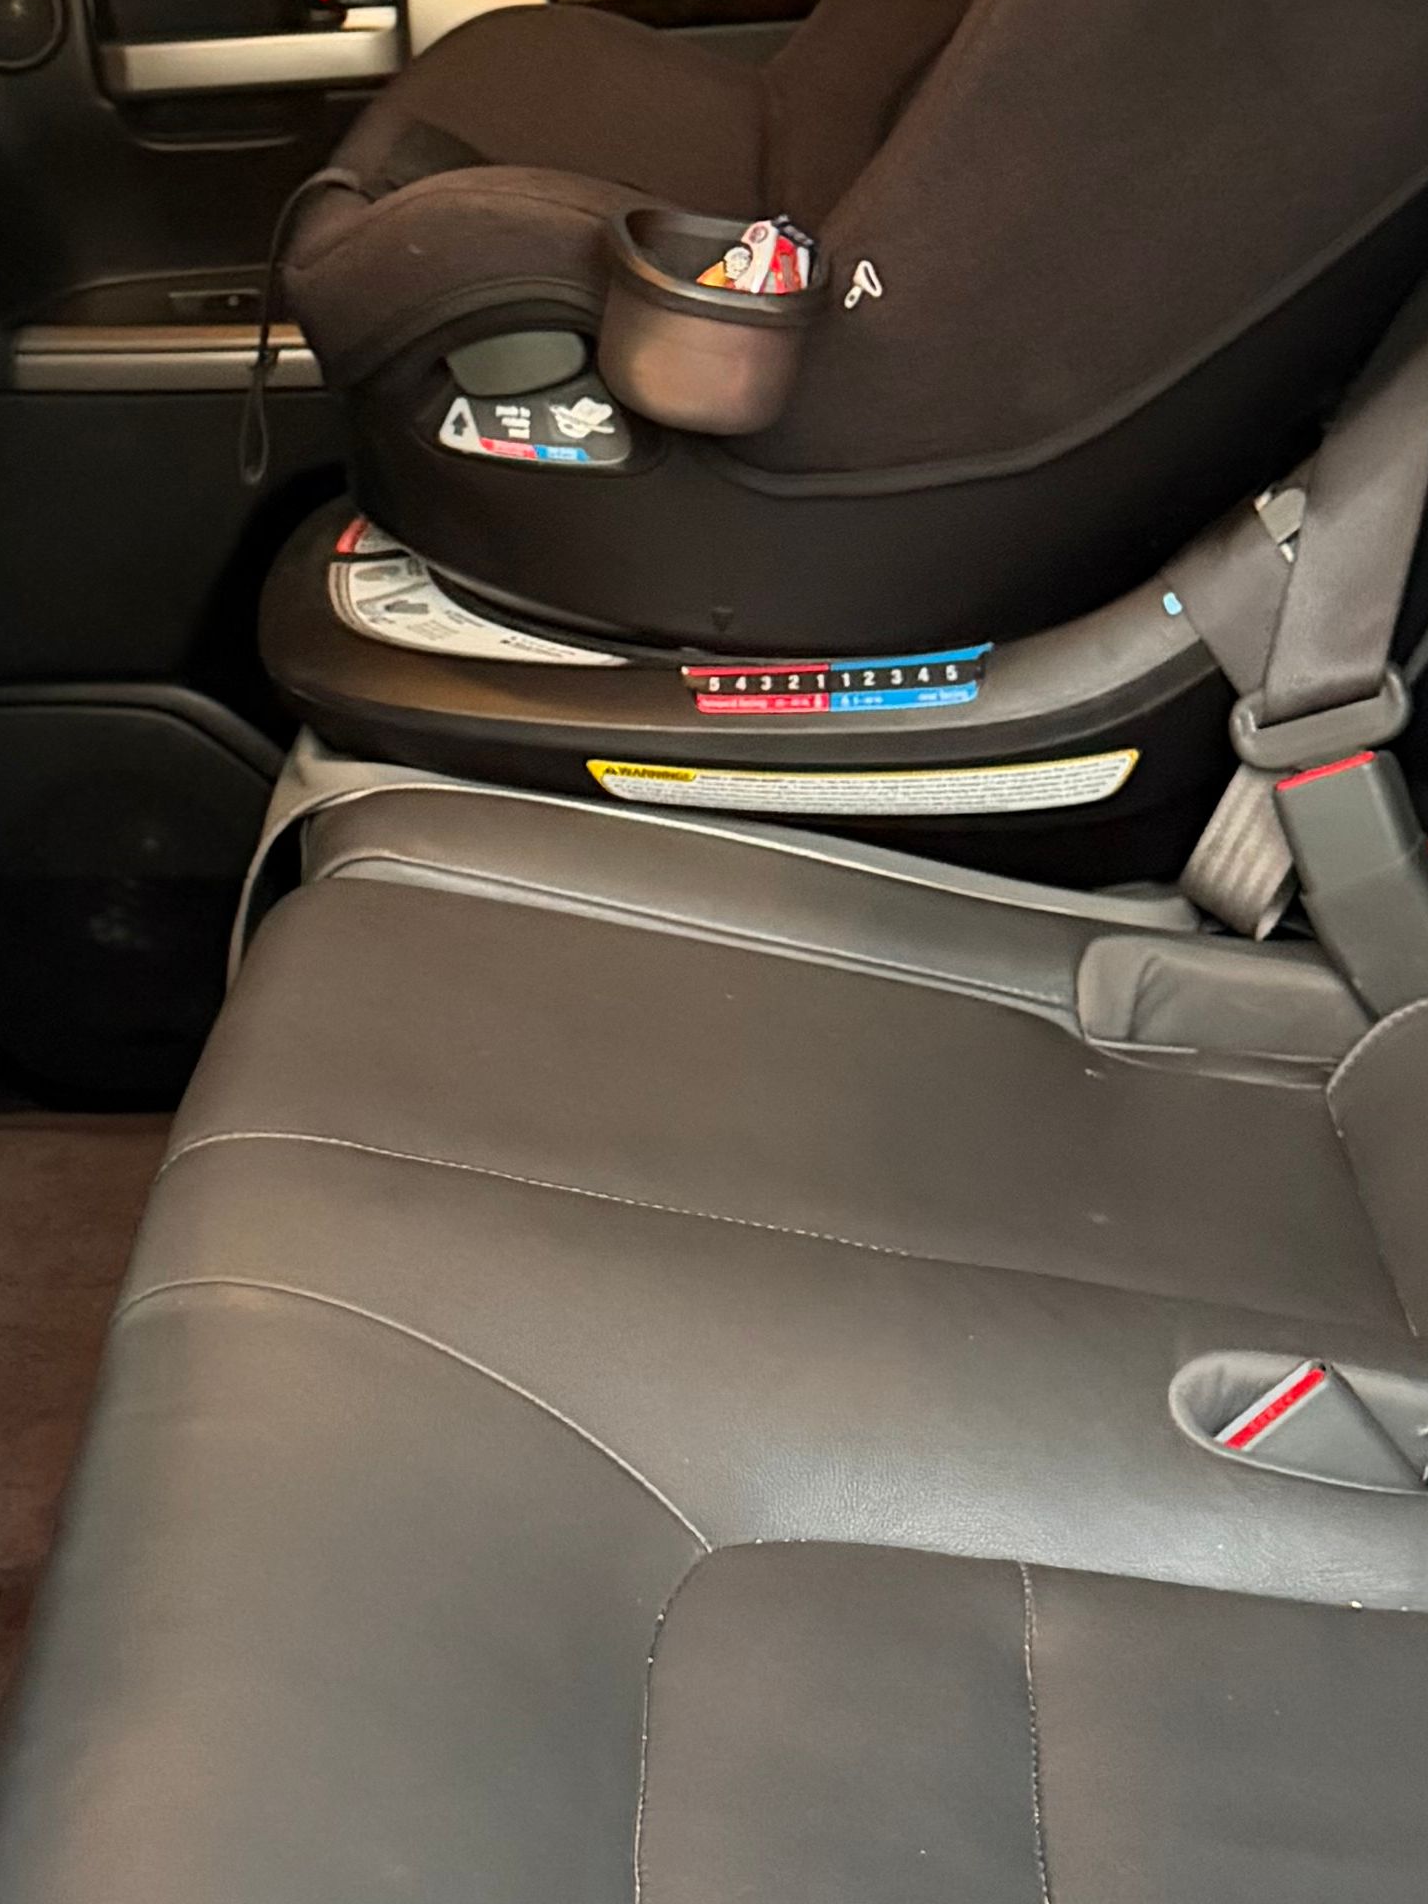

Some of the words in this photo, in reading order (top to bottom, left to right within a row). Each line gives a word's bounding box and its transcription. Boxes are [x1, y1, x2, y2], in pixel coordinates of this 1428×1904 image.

[708, 676, 721, 692] 5
[734, 676, 747, 690] 4
[760, 675, 772, 690] 3
[788, 675, 801, 690] 2
[816, 674, 826, 689] 1
[840, 673, 851, 688] 1
[863, 672, 876, 687] 2
[890, 670, 903, 685] 3
[917, 667, 930, 683] 4
[945, 665, 958, 680] 5
